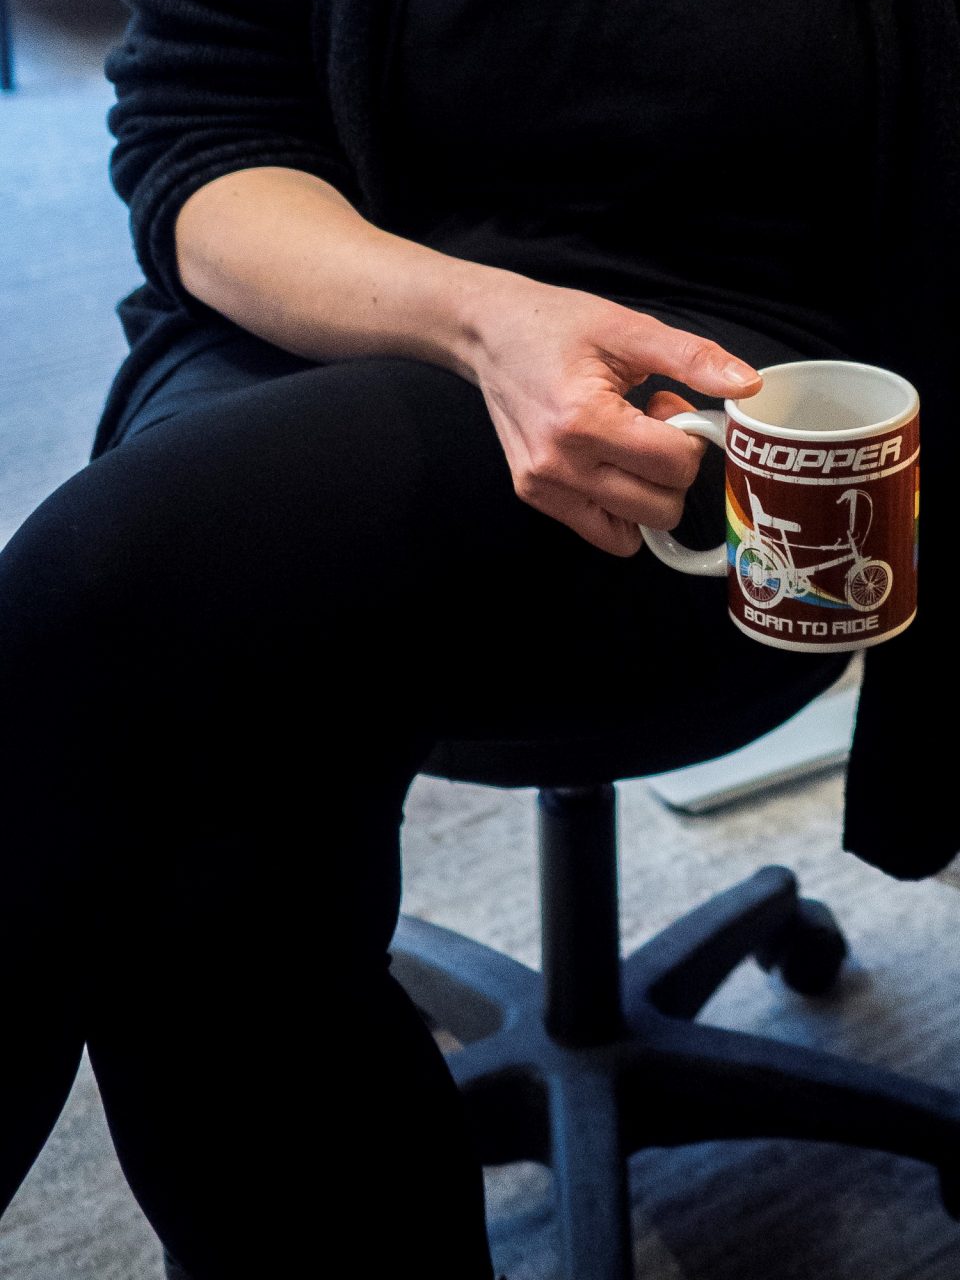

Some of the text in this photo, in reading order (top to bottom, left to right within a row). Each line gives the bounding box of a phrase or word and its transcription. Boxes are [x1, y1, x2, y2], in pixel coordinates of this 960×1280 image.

[731, 430, 902, 473] CHOPPER
[744, 607, 879, 636] BORN TO RIDE
